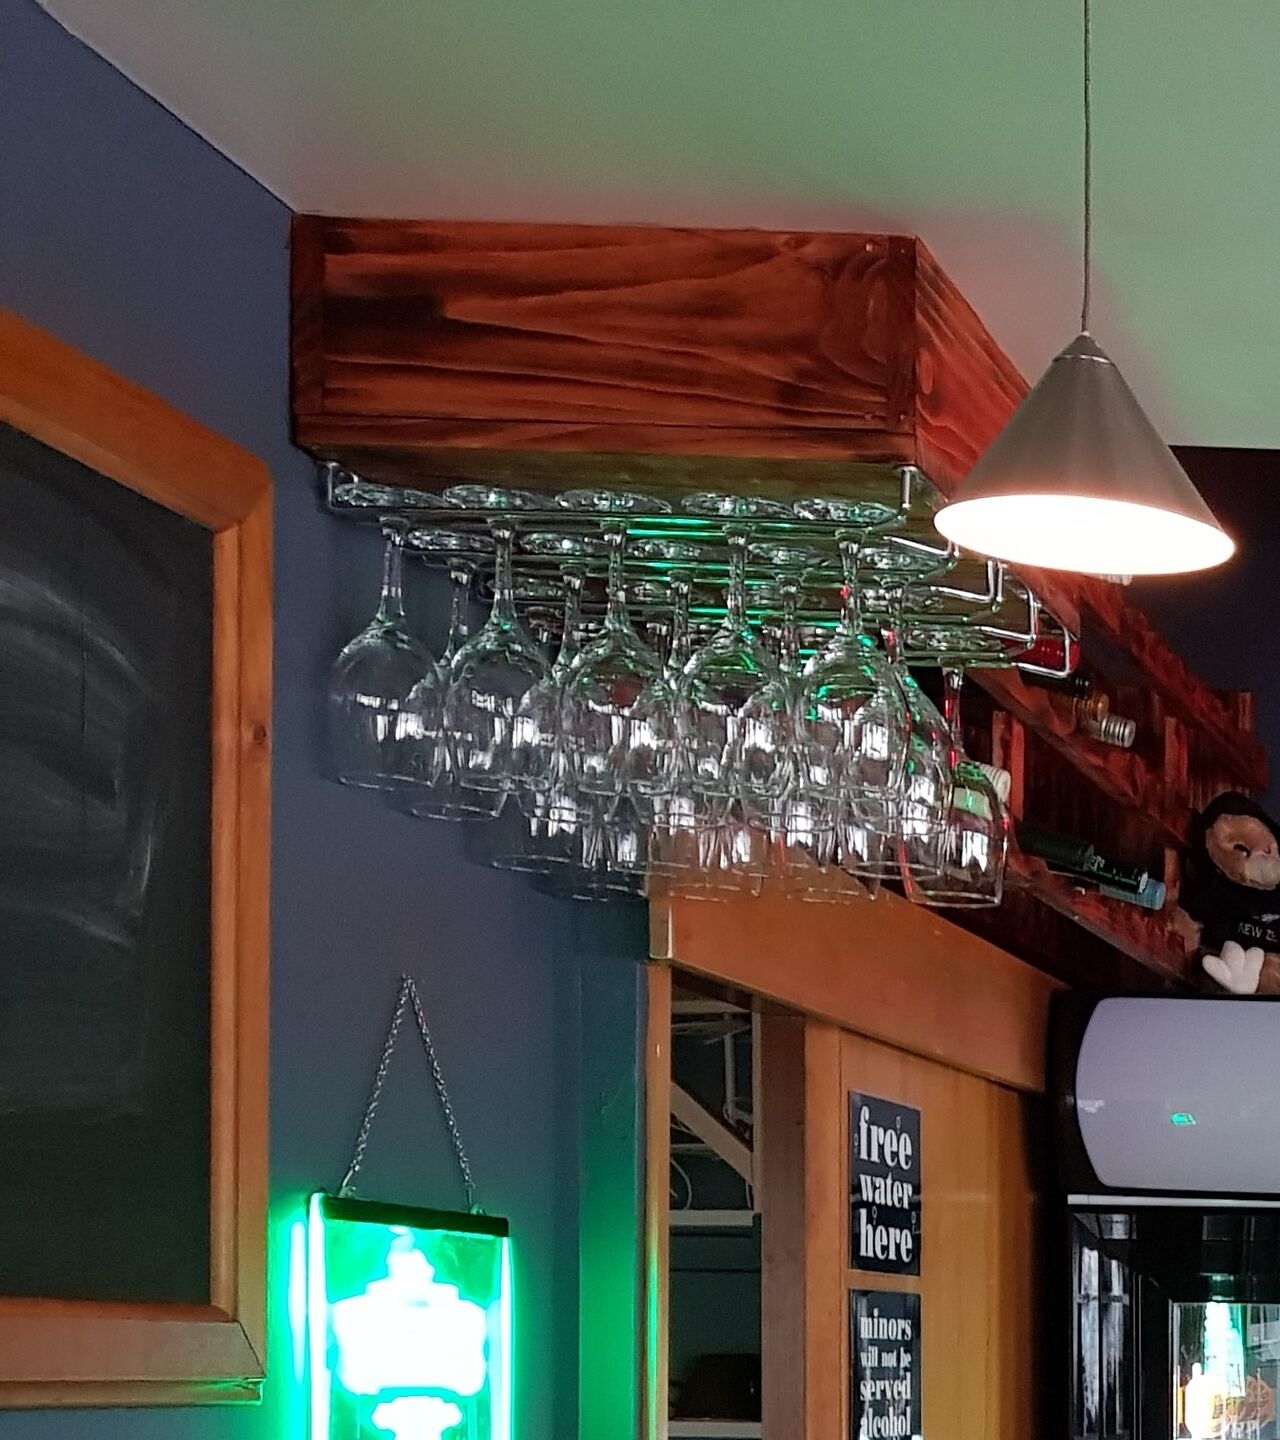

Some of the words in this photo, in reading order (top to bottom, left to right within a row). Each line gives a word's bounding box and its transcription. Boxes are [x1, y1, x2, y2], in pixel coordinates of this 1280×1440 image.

[859, 1106, 912, 1170] free
[859, 1171, 912, 1209] water
[859, 1208, 912, 1263] here
[860, 1308, 912, 1340] minors
[860, 1346, 878, 1367] will
[882, 1352, 897, 1368] not
[900, 1347, 912, 1368] be
[860, 1372, 912, 1401] served
[859, 1406, 912, 1438] alcohol
